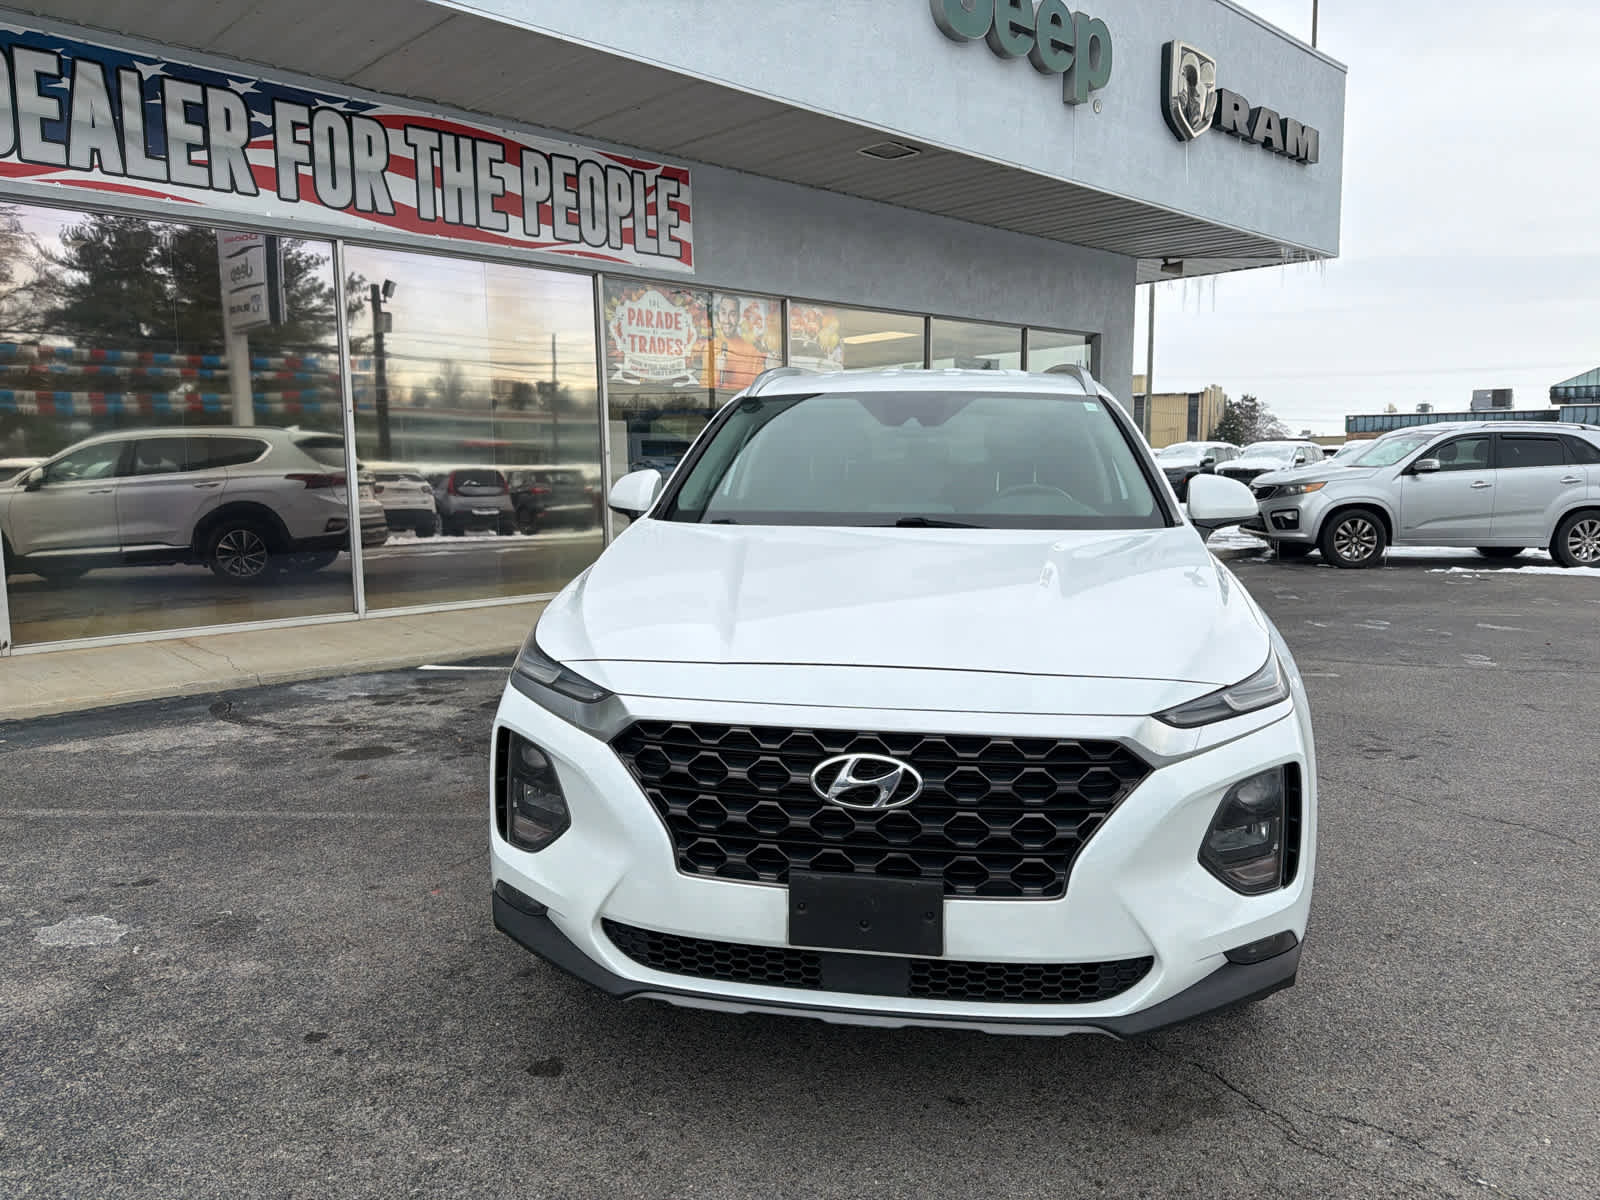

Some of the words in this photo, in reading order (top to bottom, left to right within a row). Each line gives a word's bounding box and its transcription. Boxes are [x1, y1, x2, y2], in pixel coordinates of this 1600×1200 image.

[1214, 88, 1319, 164] RAM
[272, 98, 396, 216] FOR
[404, 124, 509, 232] THE
[520, 148, 682, 259] PEOPLE
[627, 307, 683, 330] PARADE
[627, 333, 684, 356] TRADES
